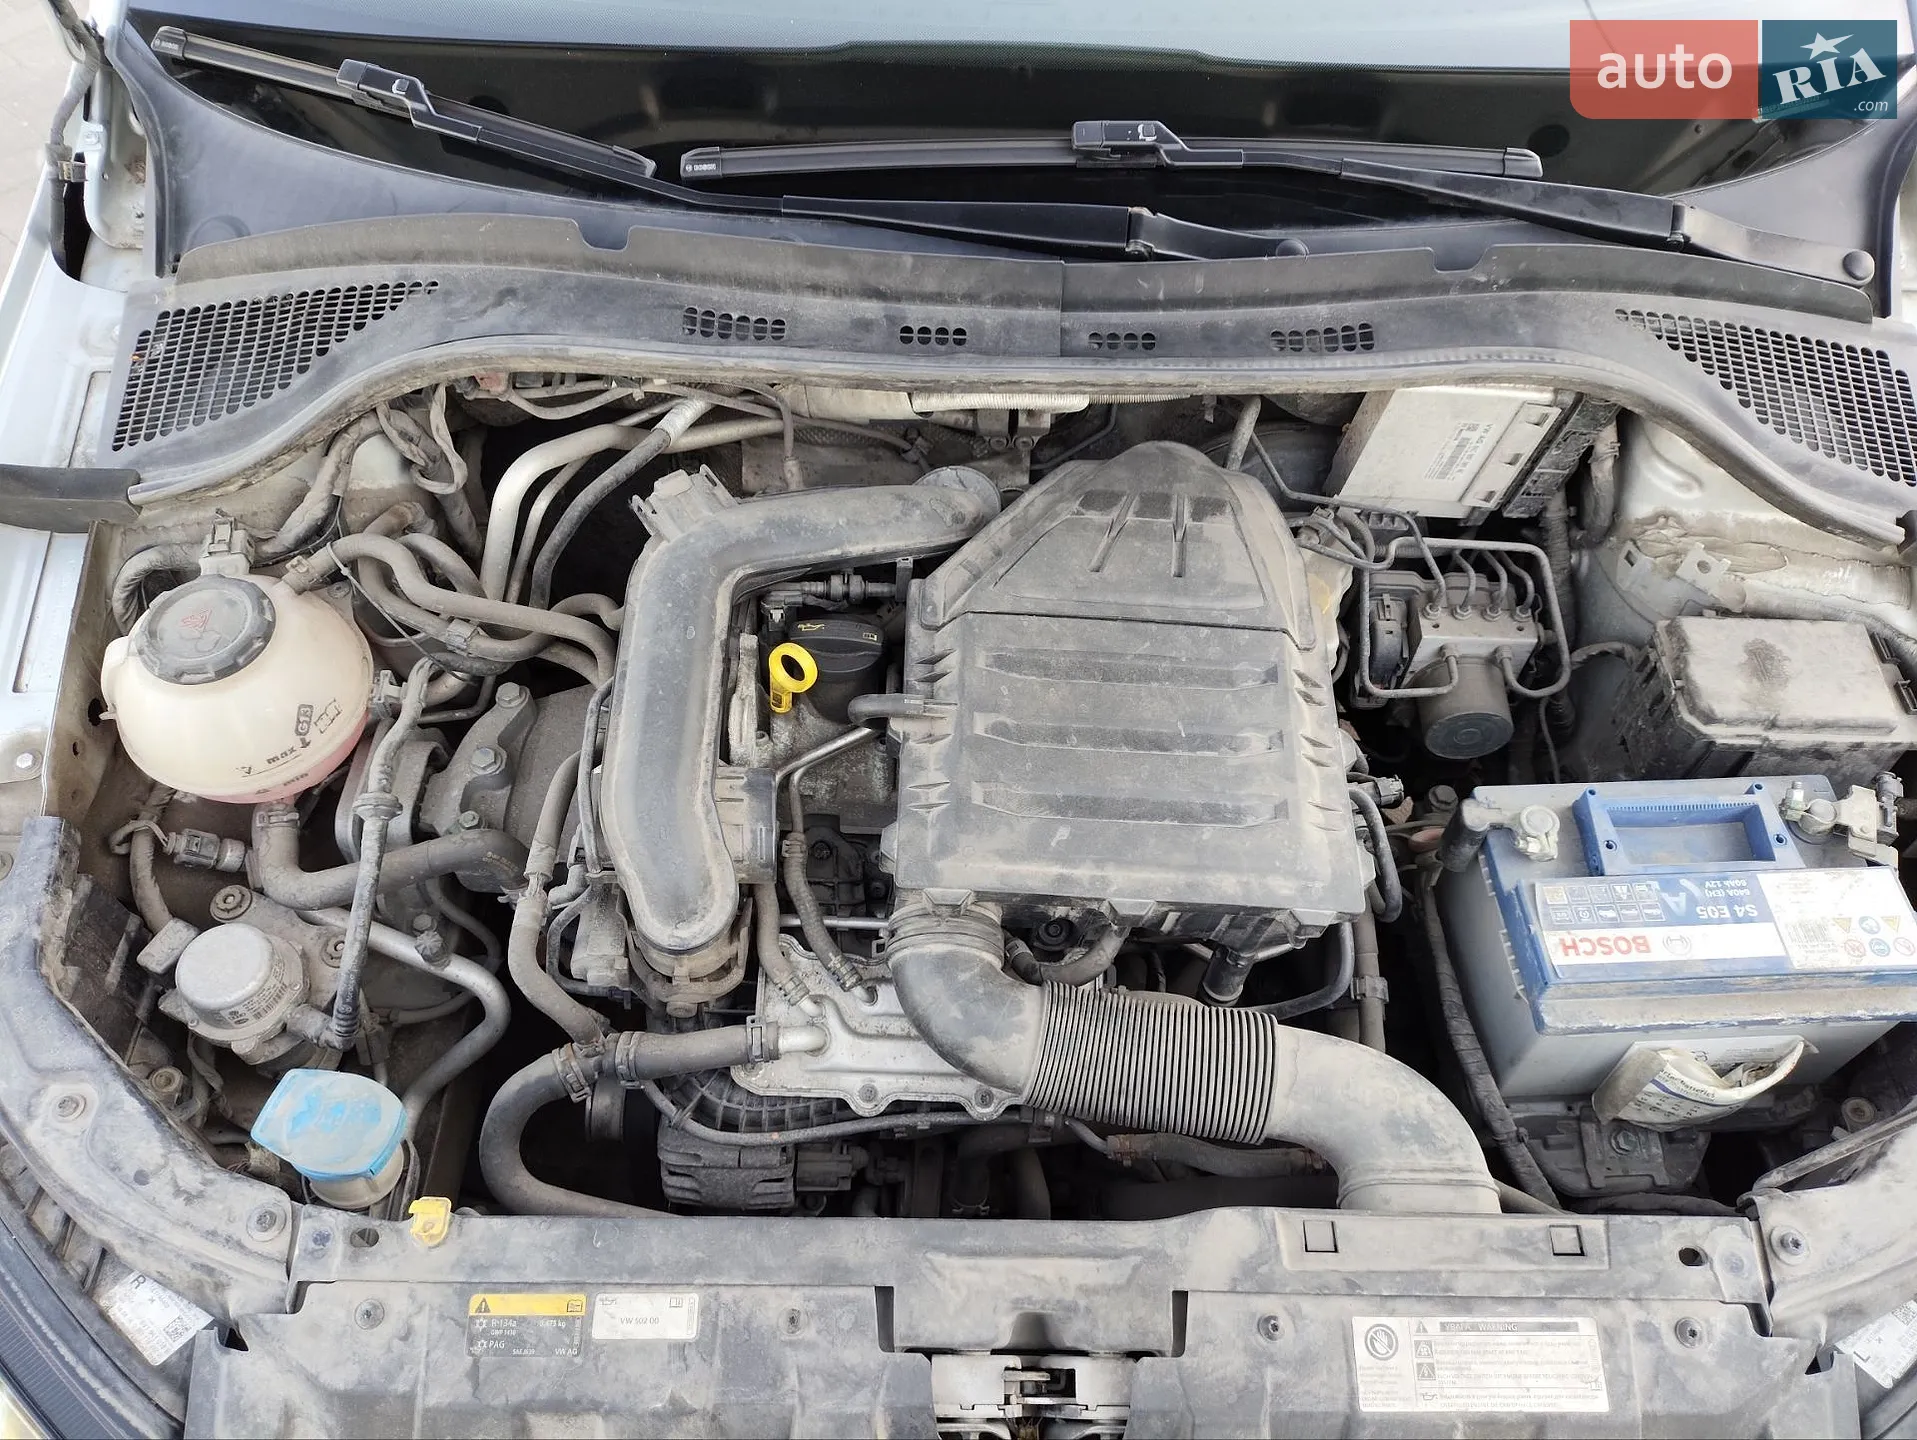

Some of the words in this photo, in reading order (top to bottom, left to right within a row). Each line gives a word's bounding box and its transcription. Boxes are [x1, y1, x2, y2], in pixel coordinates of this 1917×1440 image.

[266, 746, 297, 765] max
[1695, 904, 1731, 920] E05
[1733, 902, 1759, 918] S4
[1561, 935, 1652, 957] BOSCH
[130, 1274, 147, 1289] R
[620, 1316, 633, 1325] VW
[1478, 1322, 1518, 1332] WARNING
[488, 1340, 506, 1349] PAG
[1853, 1350, 1871, 1363] L
